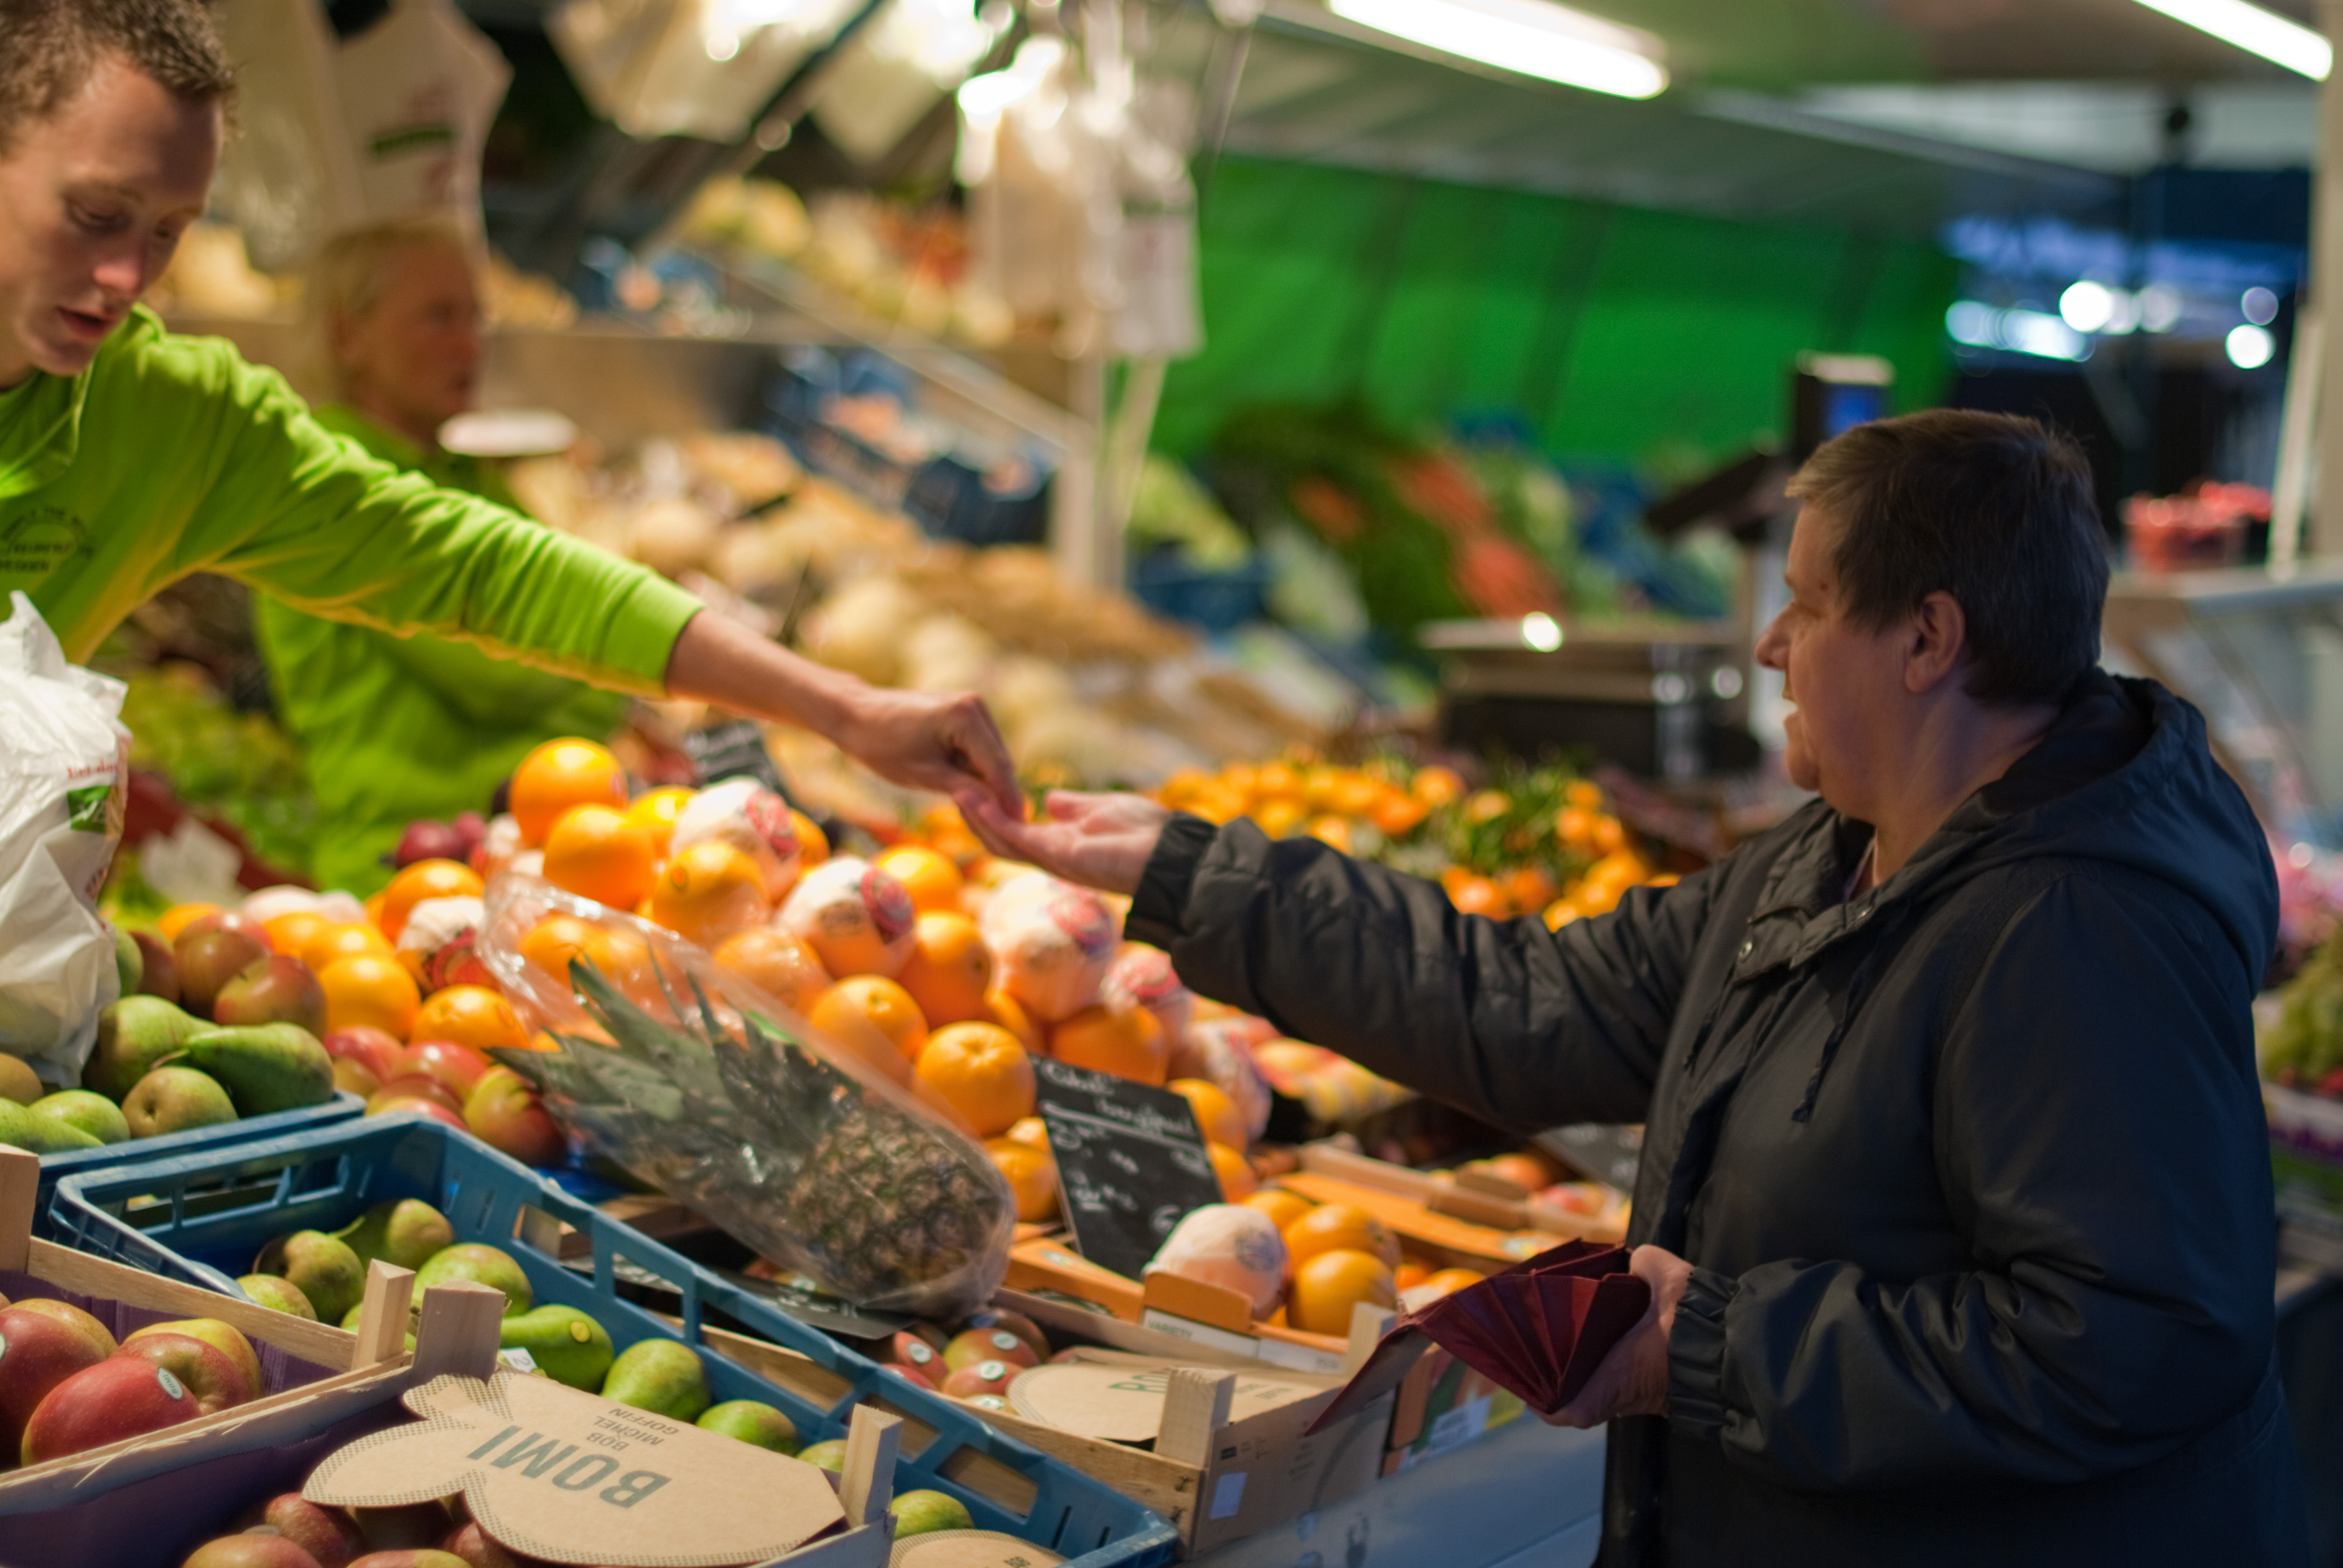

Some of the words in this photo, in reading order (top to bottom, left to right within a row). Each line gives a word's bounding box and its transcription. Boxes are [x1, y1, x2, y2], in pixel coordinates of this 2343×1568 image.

[1148, 1319, 1193, 1339] VARIETY
[594, 1416, 665, 1446] MICHEL
[609, 1408, 680, 1435] GOFFIN
[587, 1432, 630, 1451] BOB
[467, 1425, 673, 1509] BOMI
